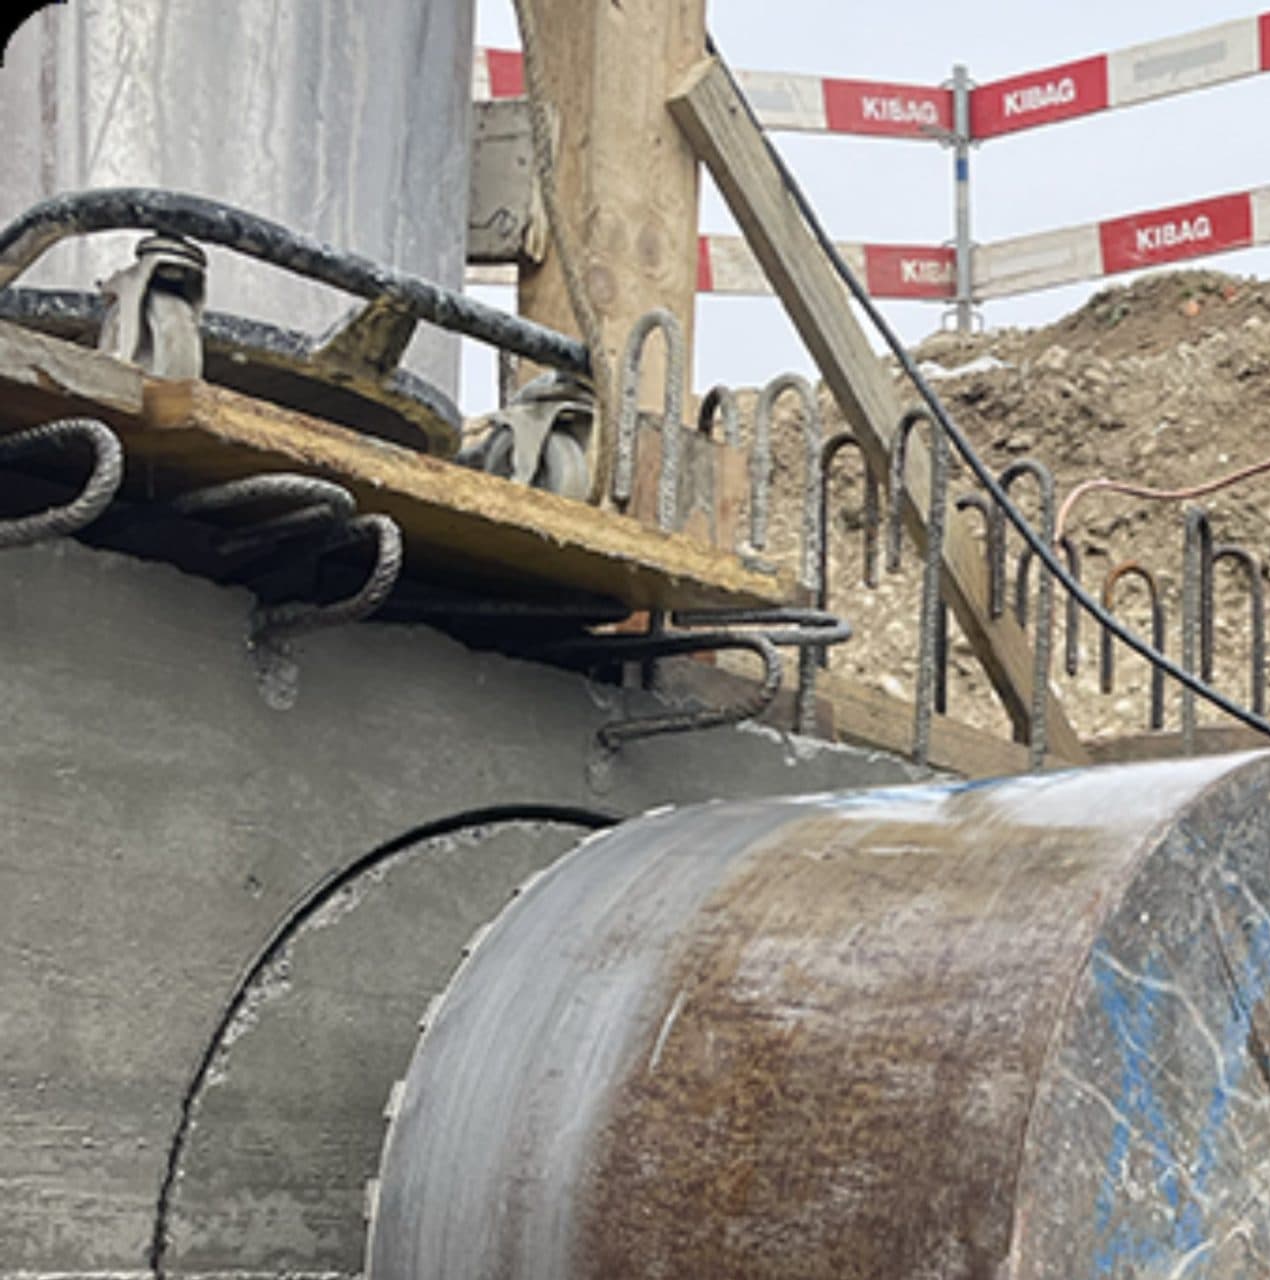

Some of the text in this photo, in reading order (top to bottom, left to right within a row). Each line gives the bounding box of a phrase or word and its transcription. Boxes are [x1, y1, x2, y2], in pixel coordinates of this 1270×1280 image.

[862, 96, 938, 124] KIBAG
[1003, 77, 1076, 116] KIBAG
[1136, 216, 1211, 251] KIBAG
[901, 259, 957, 283] KIBA
